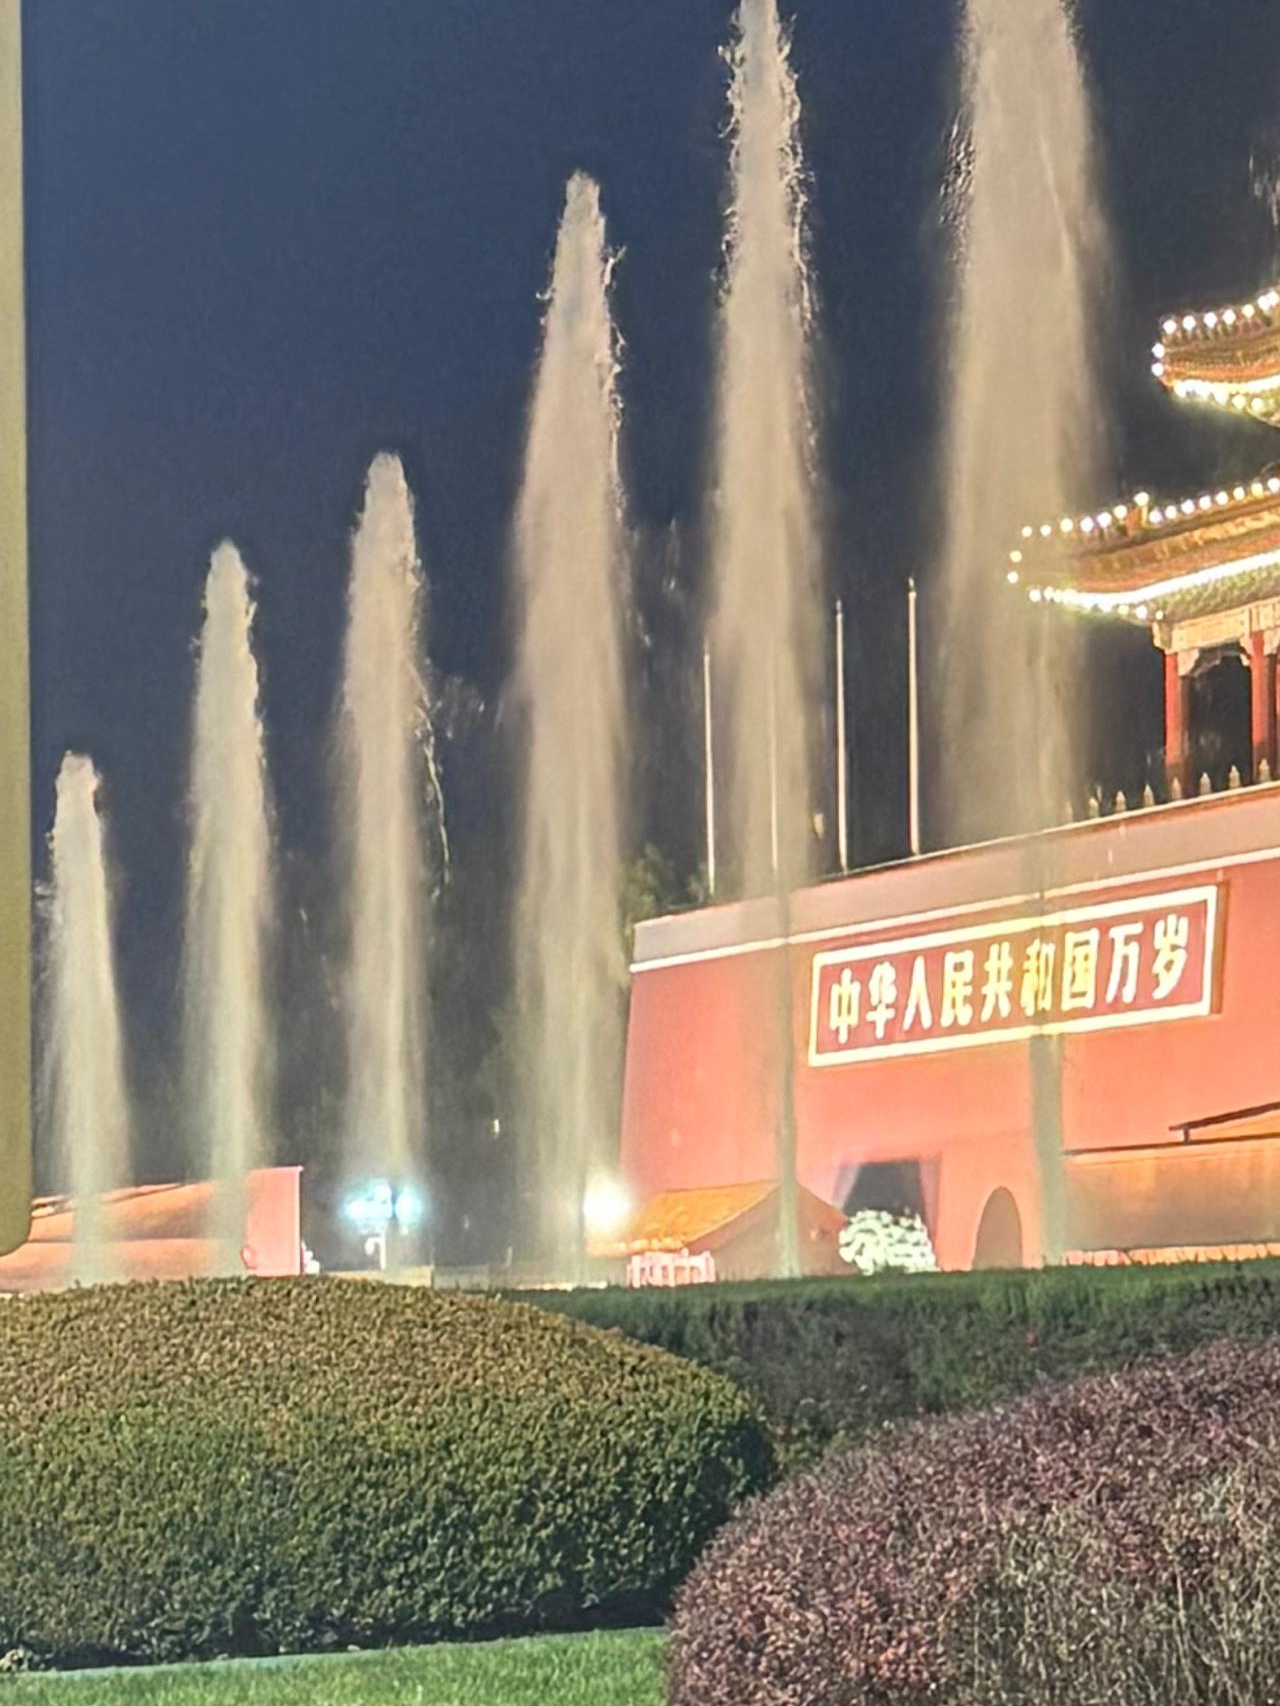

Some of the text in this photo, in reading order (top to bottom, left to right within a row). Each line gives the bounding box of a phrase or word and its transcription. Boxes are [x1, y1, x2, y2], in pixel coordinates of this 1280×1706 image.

[829, 913, 1189, 1044] 中华人民共和国万岁
